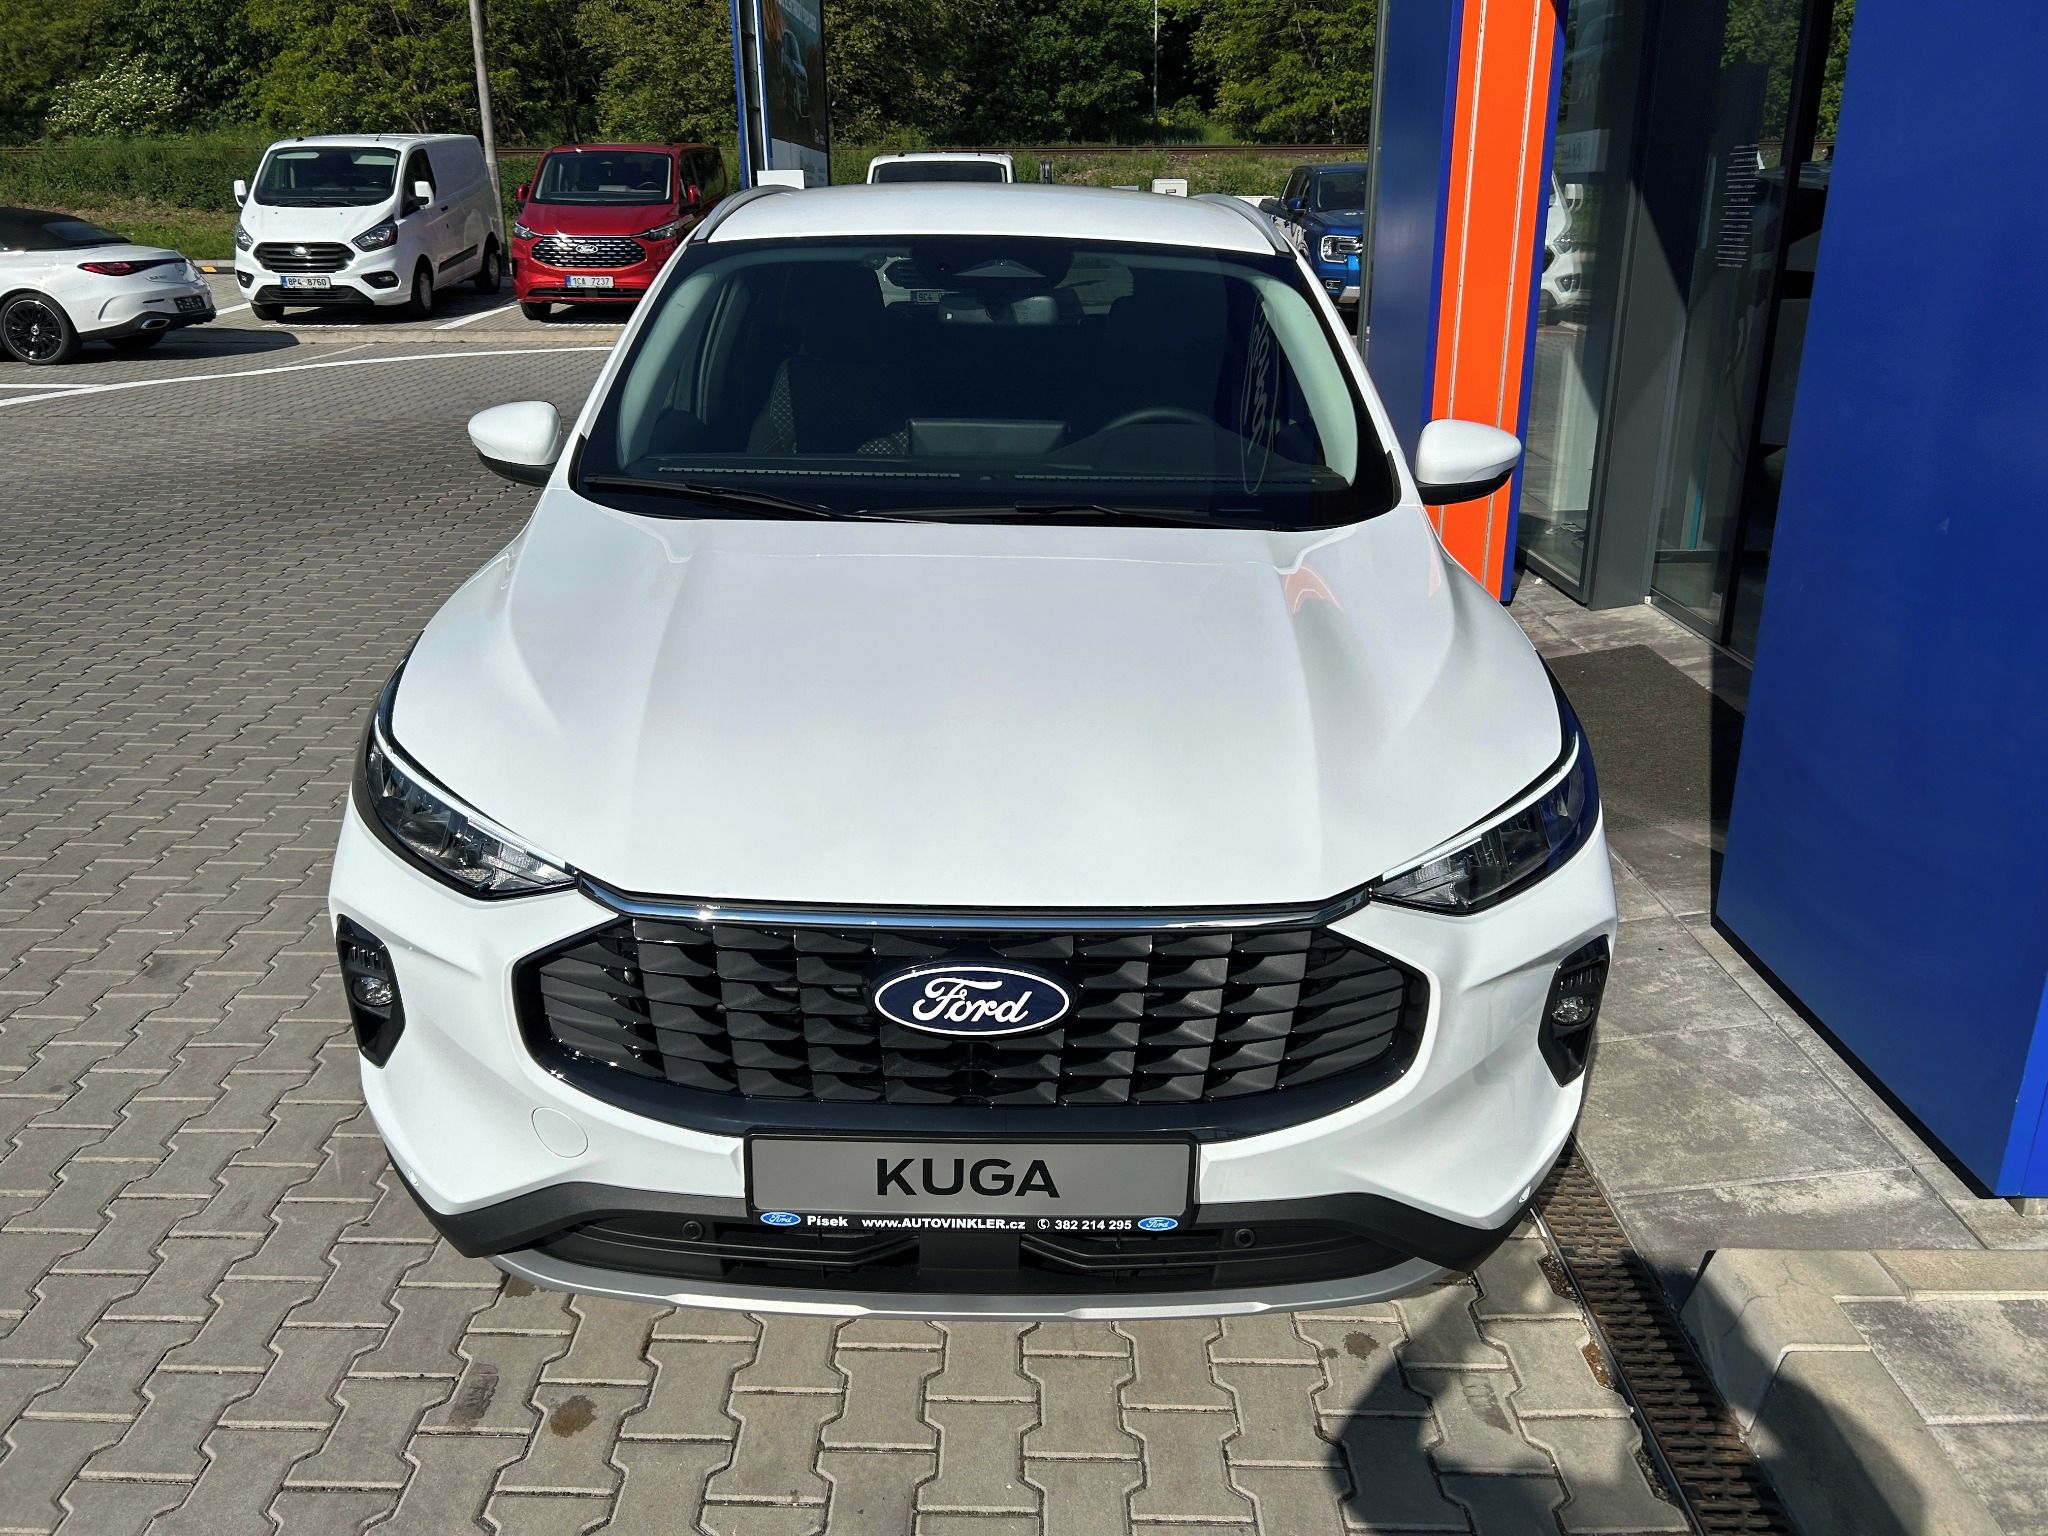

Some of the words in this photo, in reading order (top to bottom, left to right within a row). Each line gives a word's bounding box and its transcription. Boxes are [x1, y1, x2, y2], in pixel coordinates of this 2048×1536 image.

[572, 277, 586, 286] 1CA
[591, 277, 610, 286] 7237
[912, 977, 1033, 1023] Ford
[876, 1158, 1061, 1198] KUGA
[768, 1213, 792, 1224] Ford
[806, 1214, 849, 1227] Písek
[861, 1217, 1026, 1230] www.AUTOVINKLER.cz
[1054, 1219, 1079, 1230] 382
[1081, 1219, 1106, 1231] 214
[1108, 1219, 1132, 1231] 295
[1145, 1219, 1169, 1229] Ford
